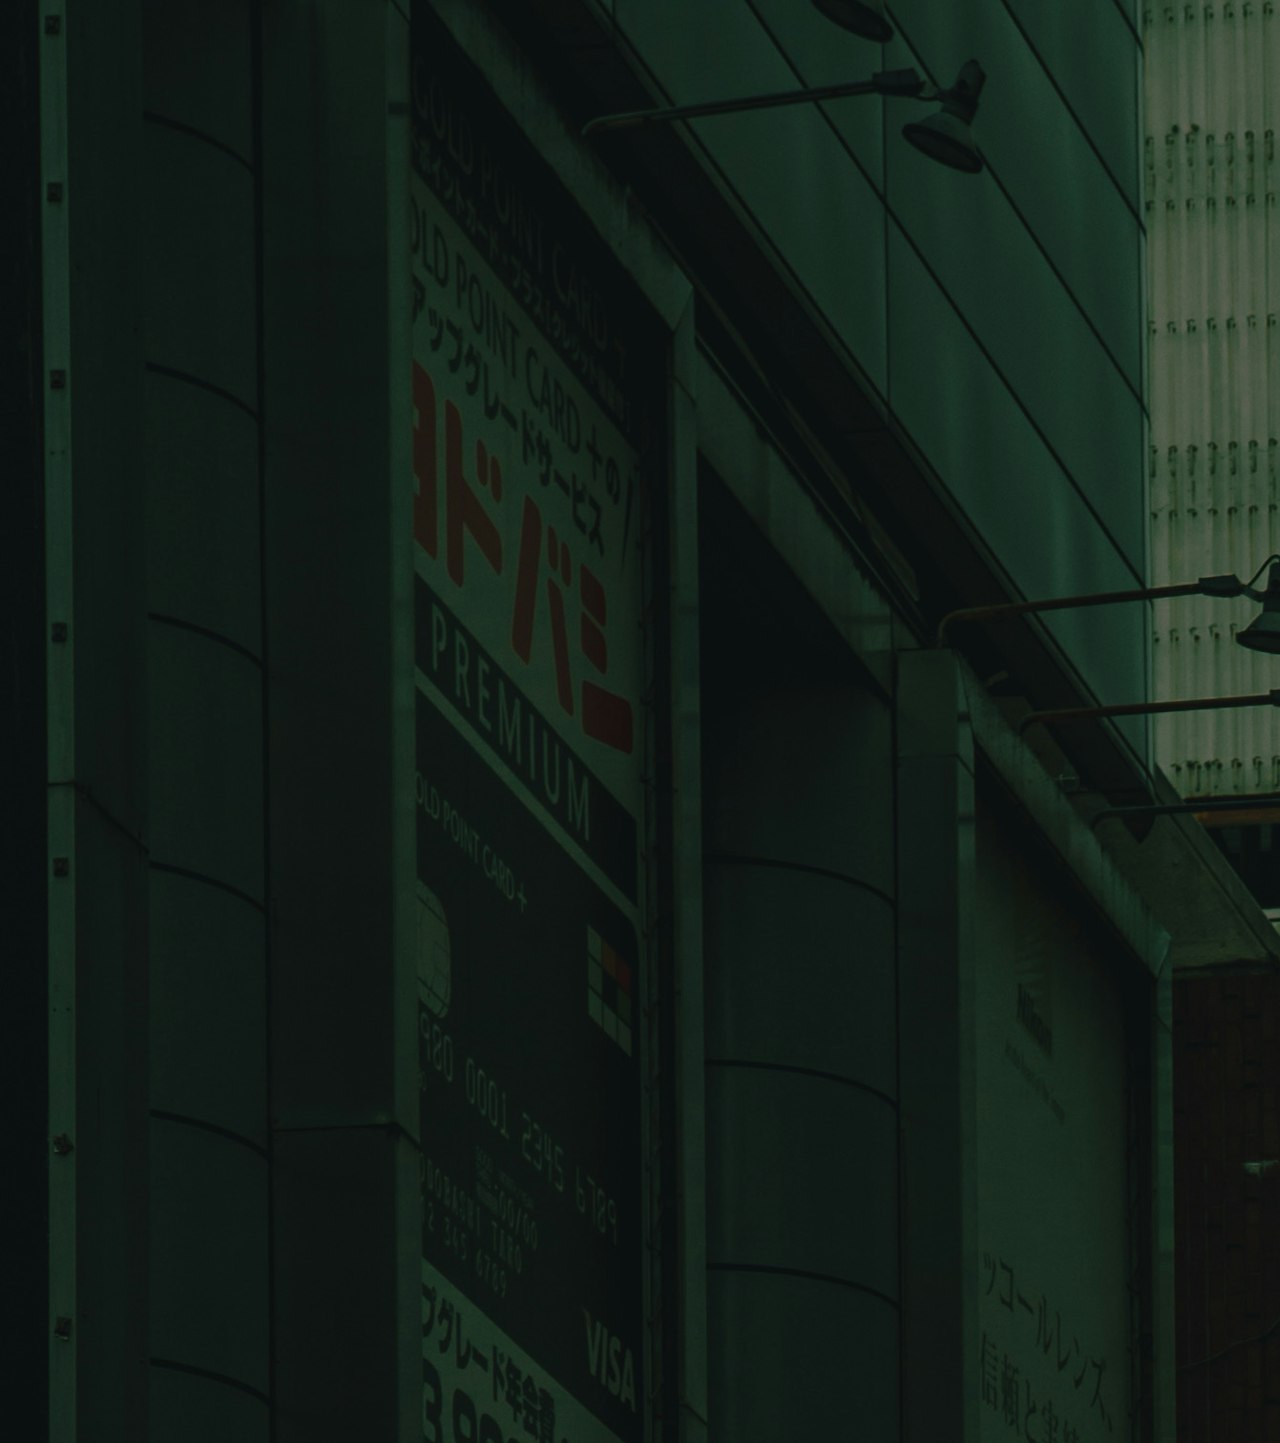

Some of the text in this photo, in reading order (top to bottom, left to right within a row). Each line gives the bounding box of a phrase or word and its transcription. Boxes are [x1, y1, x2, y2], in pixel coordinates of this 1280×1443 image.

[413, 55, 475, 177] GOLD
[481, 145, 543, 273] POINT
[553, 242, 608, 351] CARD
[456, 252, 519, 379] POINT
[525, 346, 580, 453] CARD
[431, 603, 591, 841] PREMIUM
[443, 804, 481, 862] POINT
[482, 844, 515, 902] CARD
[464, 1057, 510, 1140] 0001
[520, 1111, 565, 1194] 2345
[581, 1305, 637, 1413] VISA
